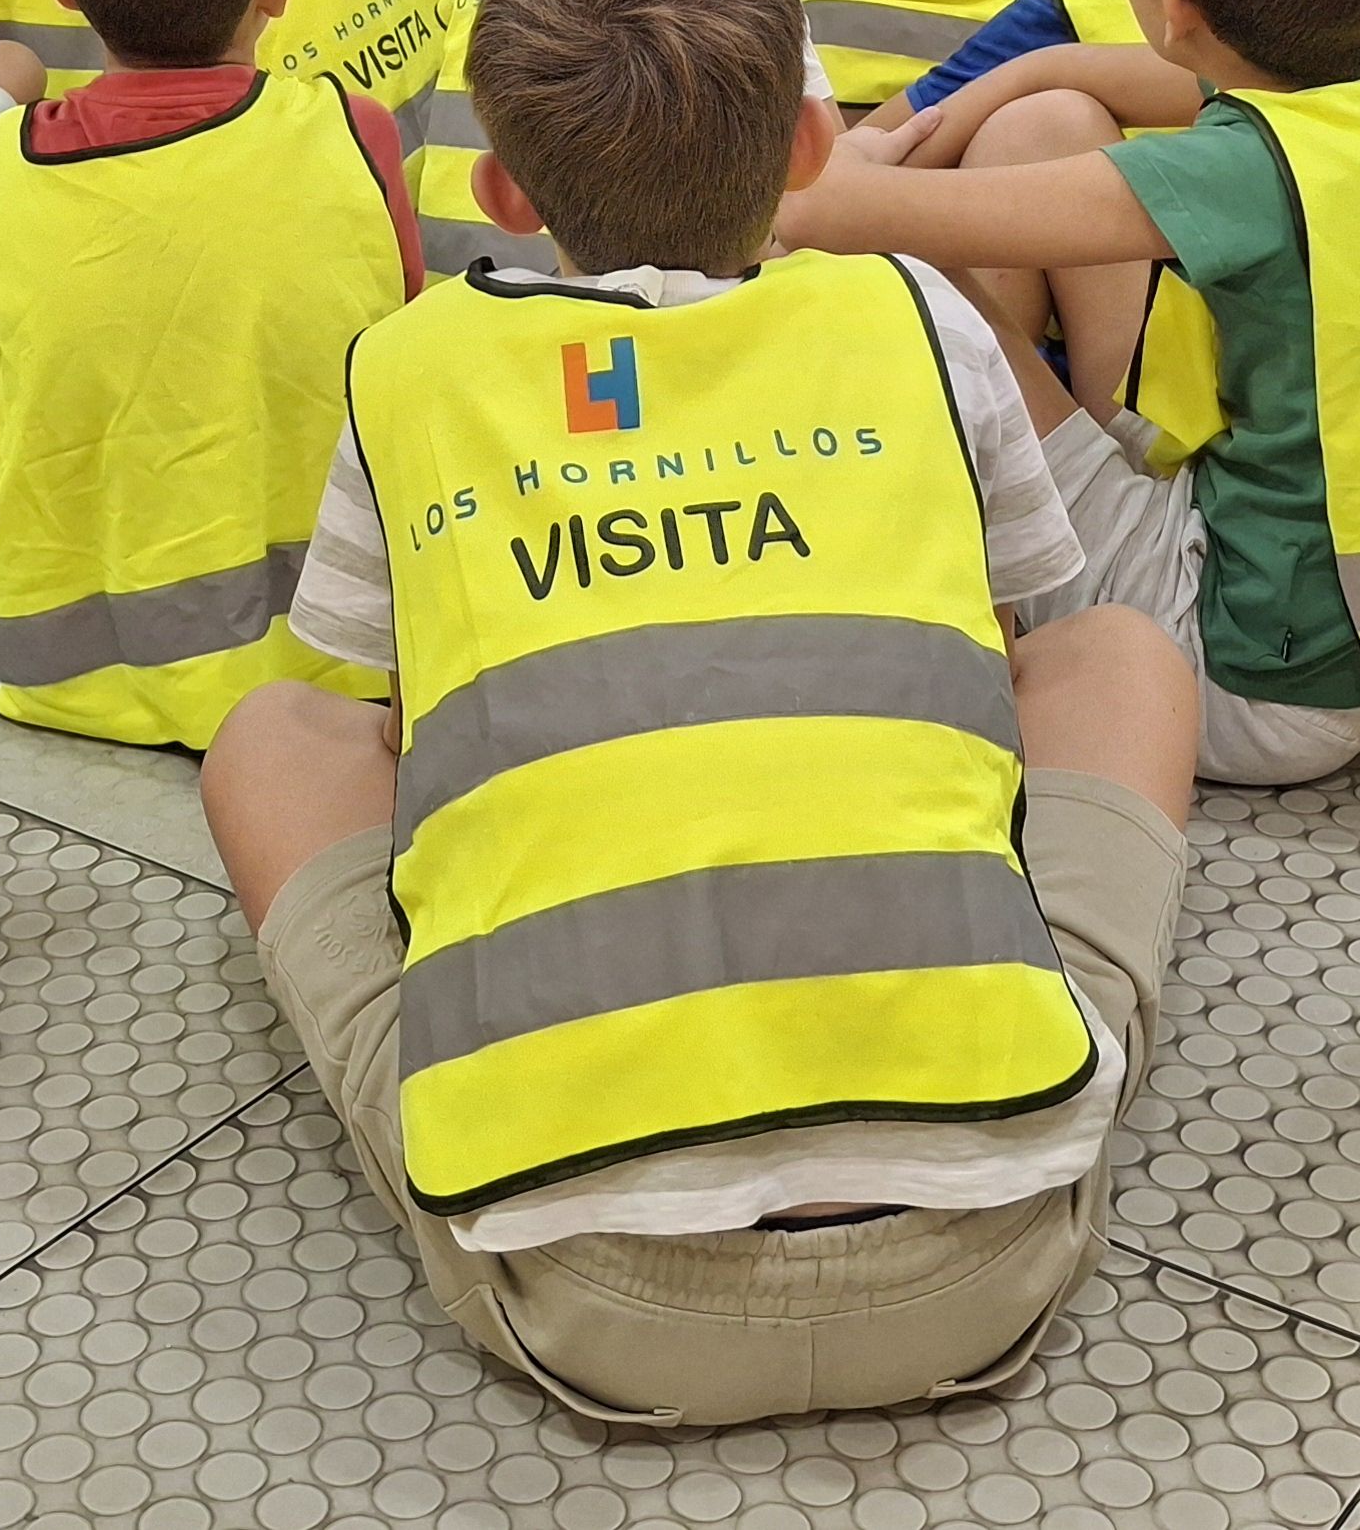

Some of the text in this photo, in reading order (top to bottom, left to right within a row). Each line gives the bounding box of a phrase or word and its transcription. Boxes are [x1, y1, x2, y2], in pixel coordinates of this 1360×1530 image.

[342, 9, 432, 89] VISITA
[410, 427, 882, 552] LOS HORNILLOS
[510, 492, 811, 601] VISITA
